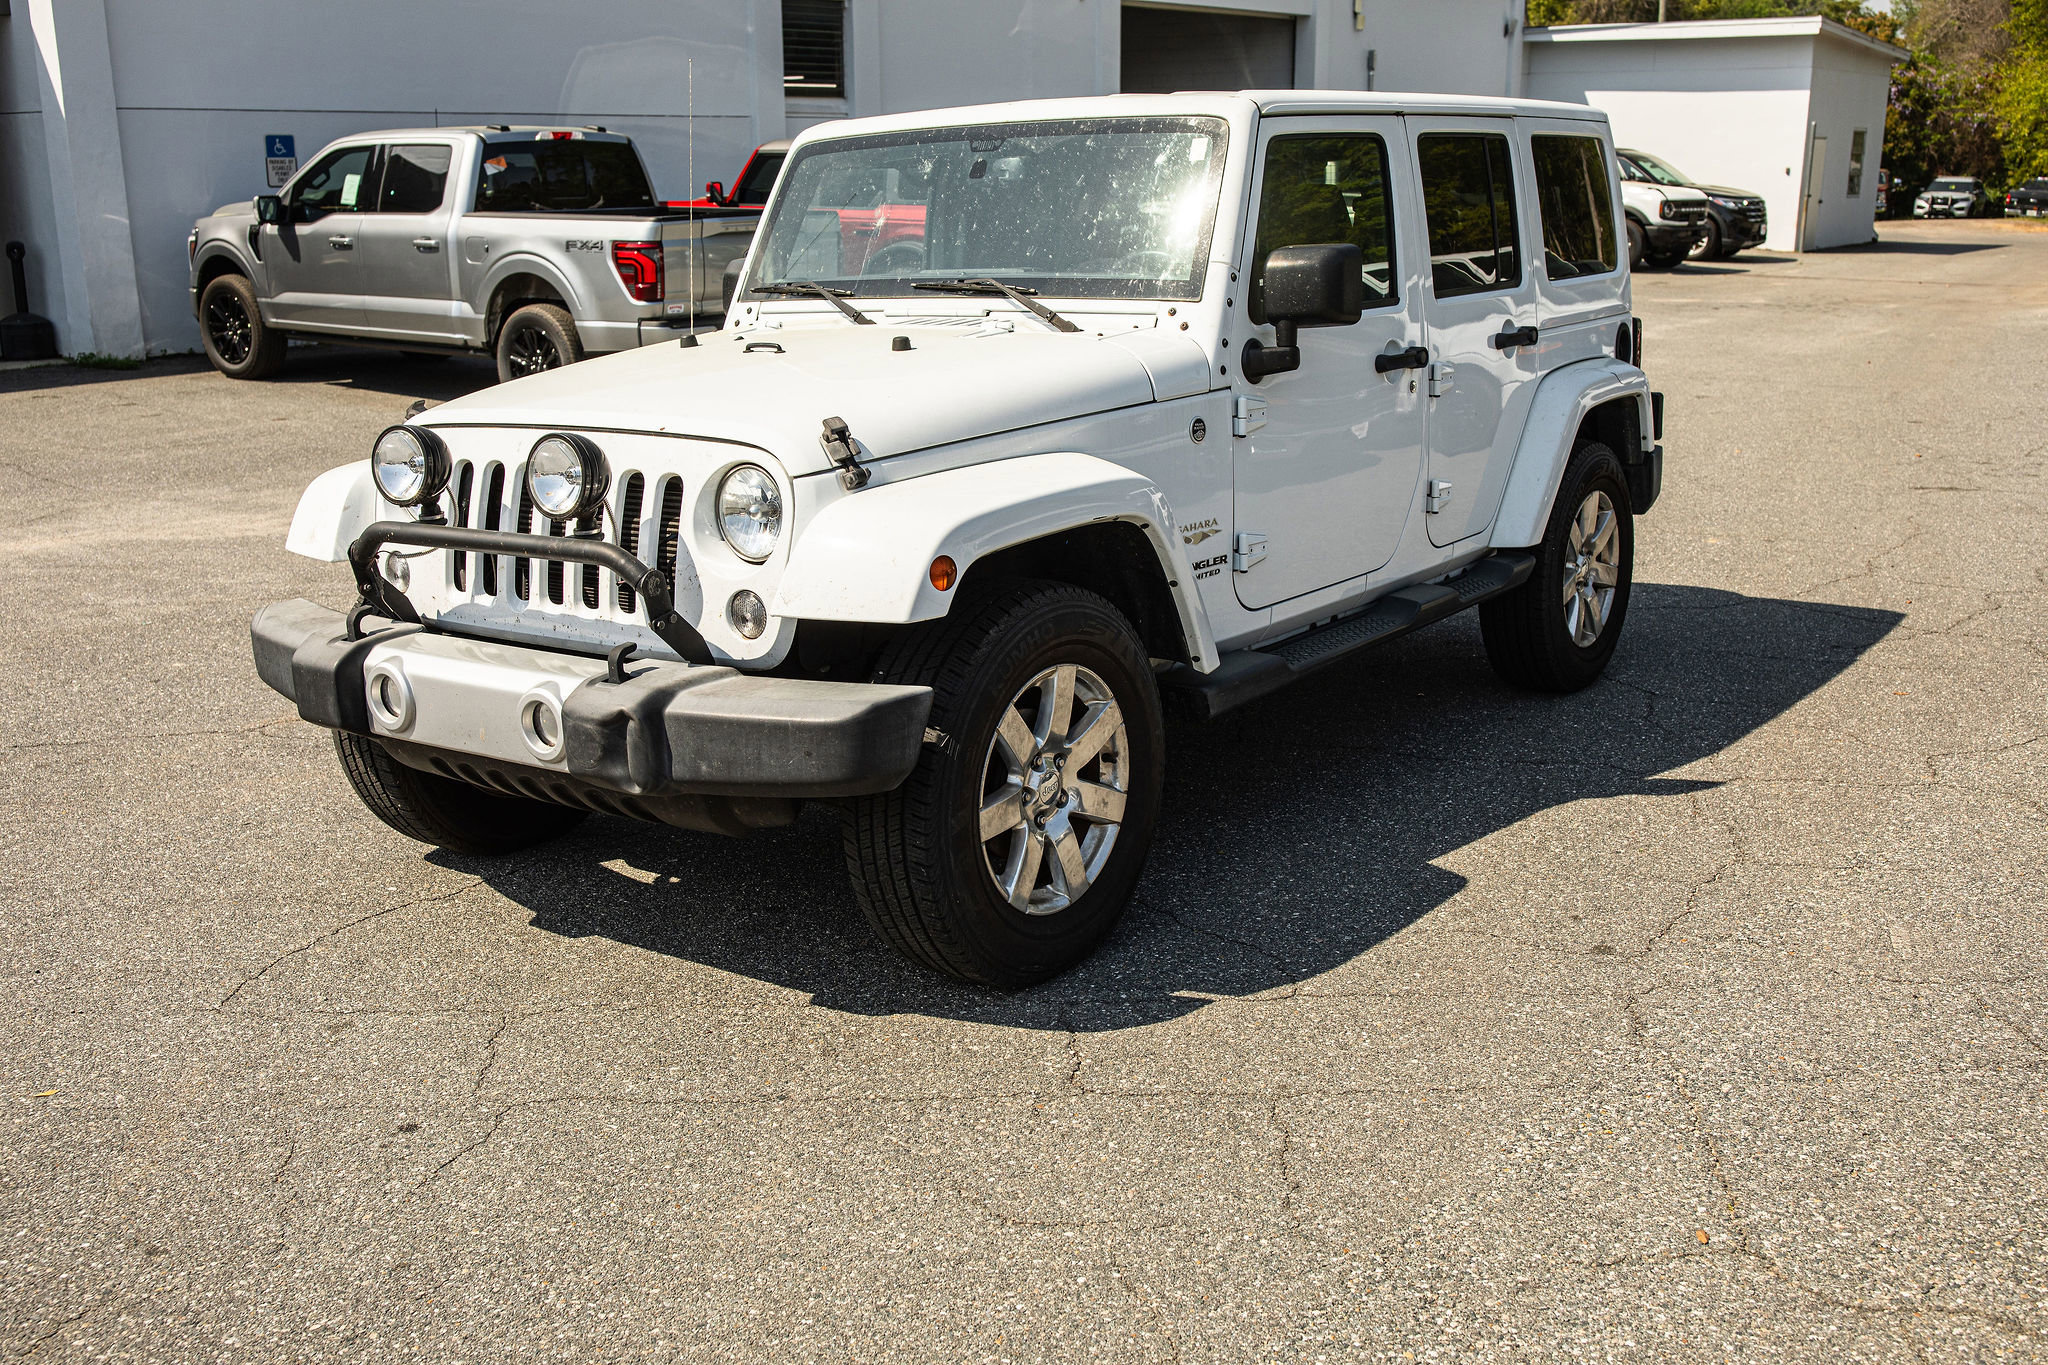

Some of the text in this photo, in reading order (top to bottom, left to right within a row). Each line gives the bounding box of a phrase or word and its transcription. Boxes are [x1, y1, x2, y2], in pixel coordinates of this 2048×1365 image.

[565, 240, 603, 252] FX4
[1192, 554, 1228, 571] NGLER
[1195, 568, 1221, 580] MITED
